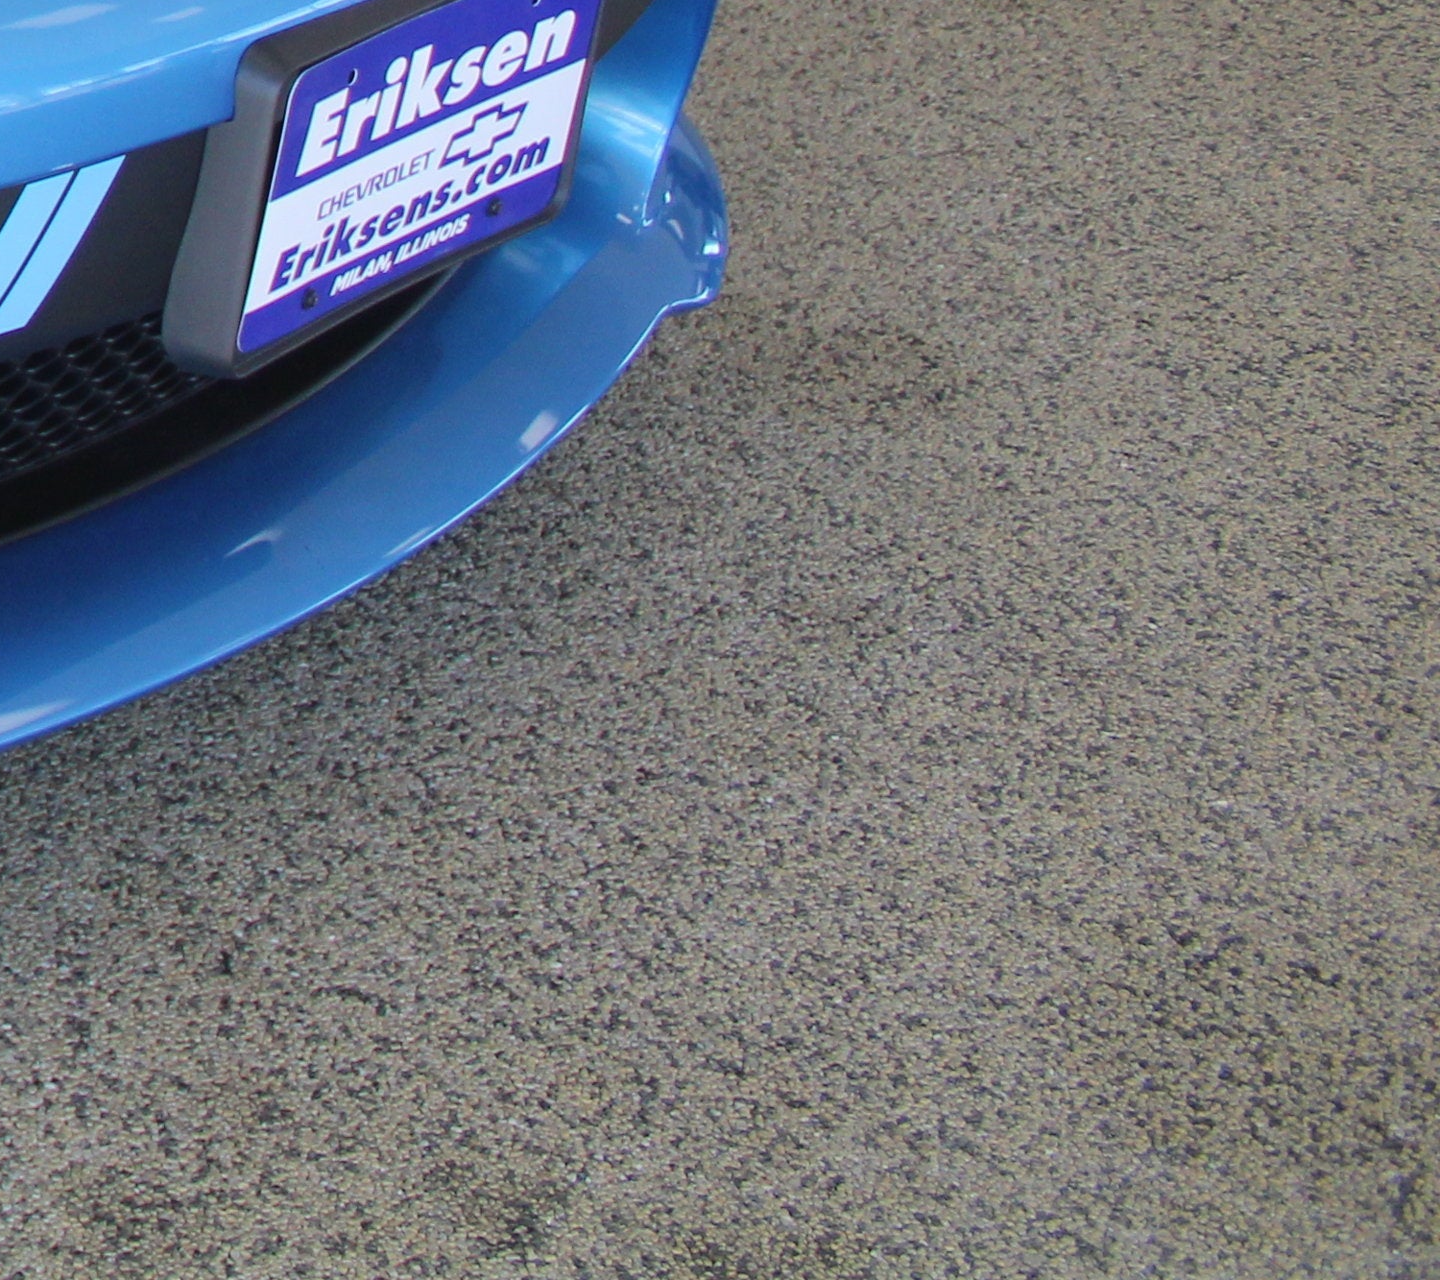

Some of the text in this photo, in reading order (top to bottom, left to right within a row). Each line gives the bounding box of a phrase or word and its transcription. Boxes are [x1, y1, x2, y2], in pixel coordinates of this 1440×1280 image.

[294, 8, 577, 177] Eriksen
[268, 134, 551, 295] Eriksens.com
[316, 148, 437, 221] CHEVROLET
[329, 213, 472, 297] MILAN, ILLINOIS
